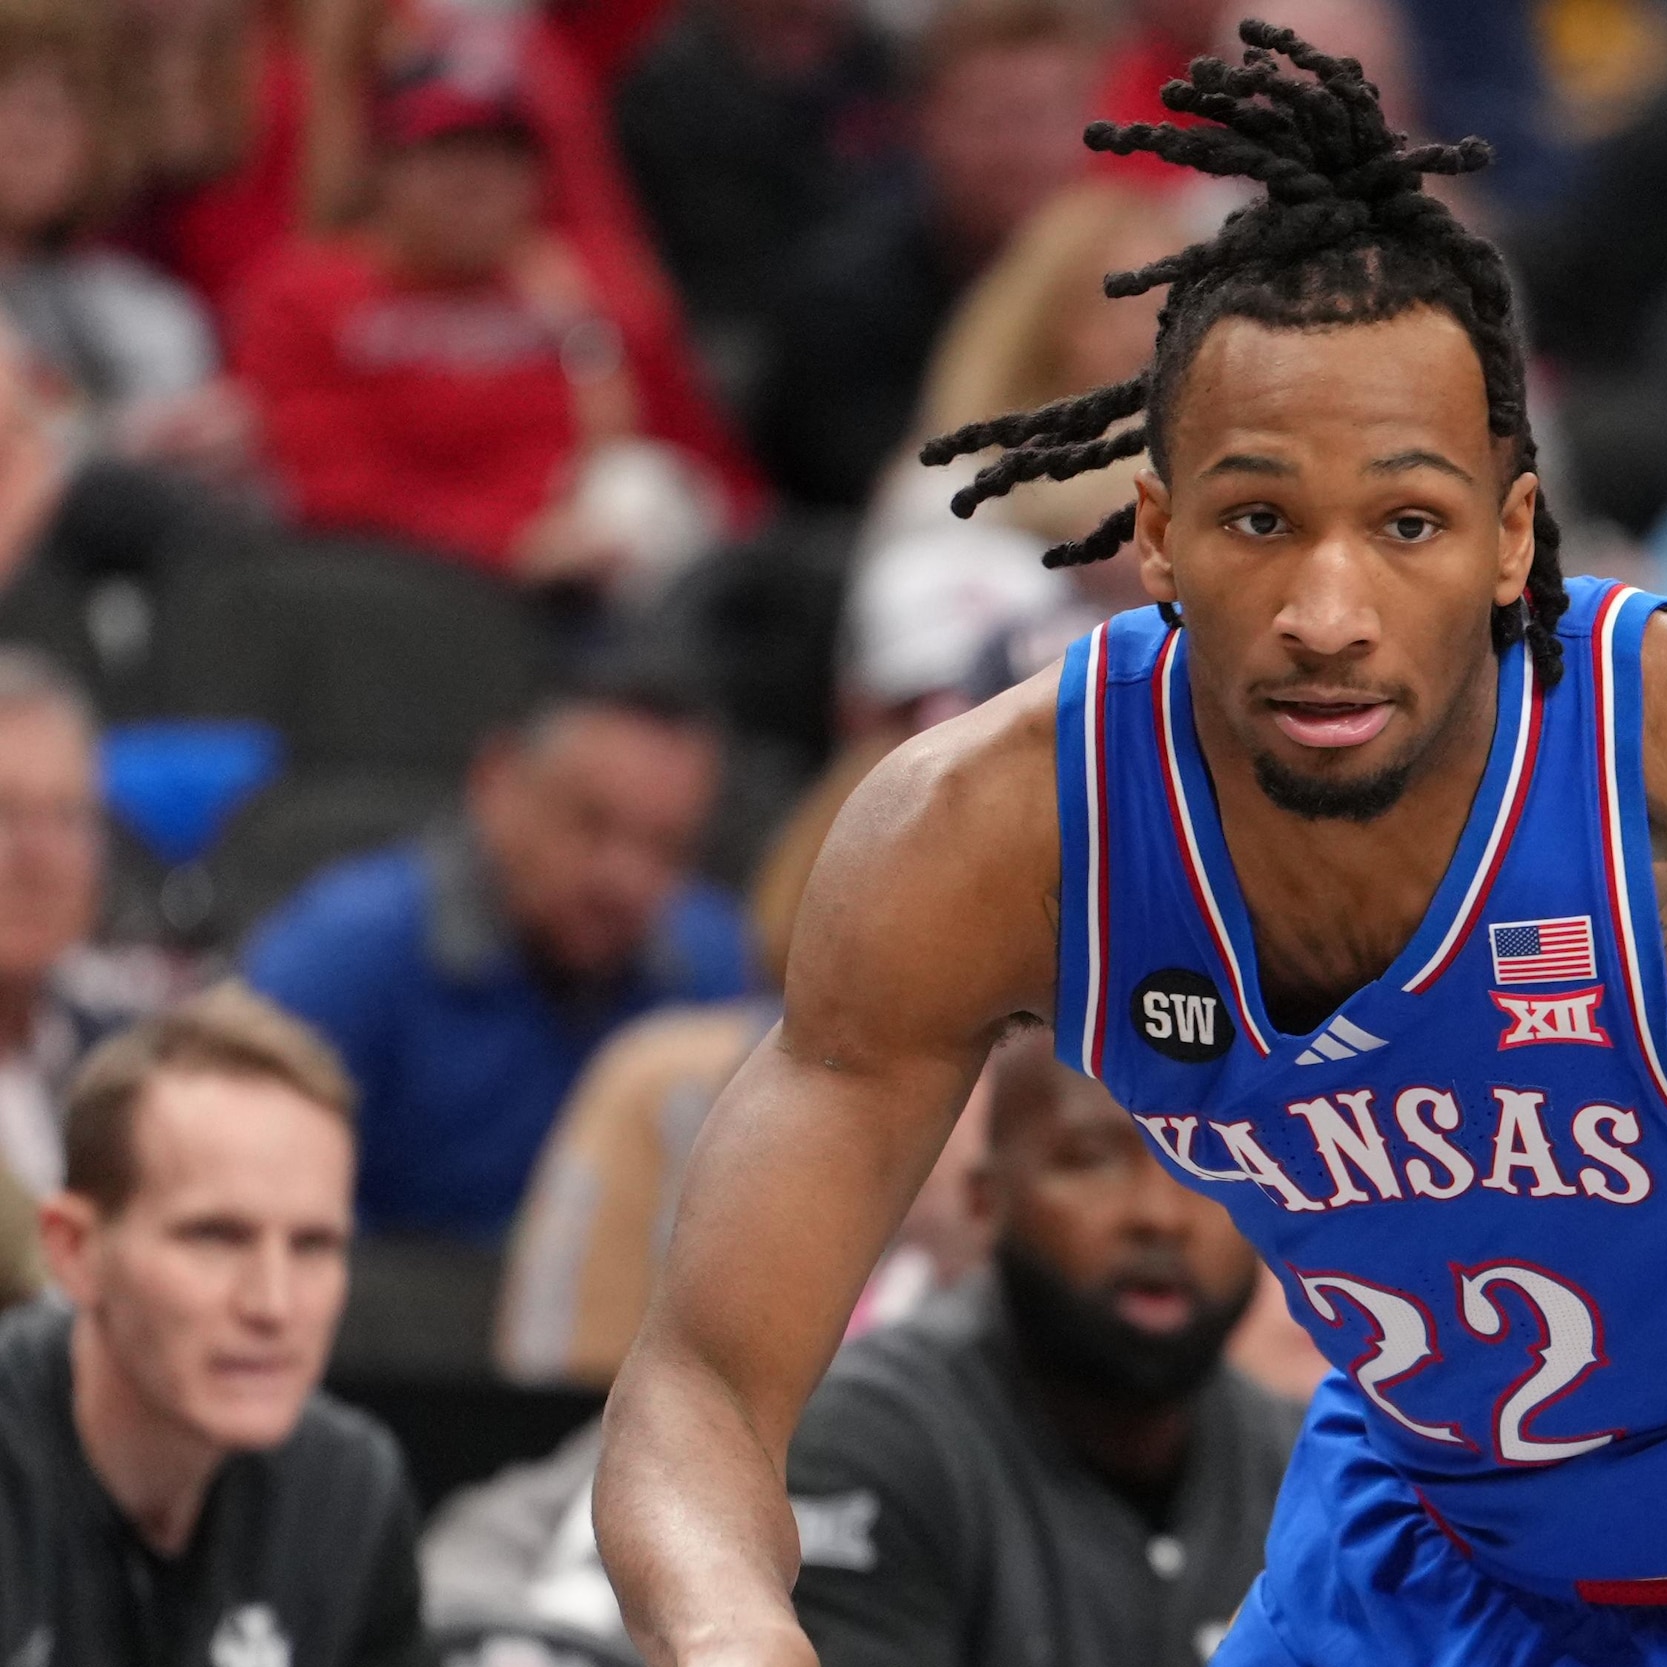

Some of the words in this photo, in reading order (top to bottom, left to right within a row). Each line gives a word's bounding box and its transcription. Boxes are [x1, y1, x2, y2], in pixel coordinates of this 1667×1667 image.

[1143, 990, 1214, 1046] SW
[1494, 991, 1605, 1045] XII
[1133, 1085, 1654, 1212] KANSAS
[1288, 1258, 1623, 1467] 22
